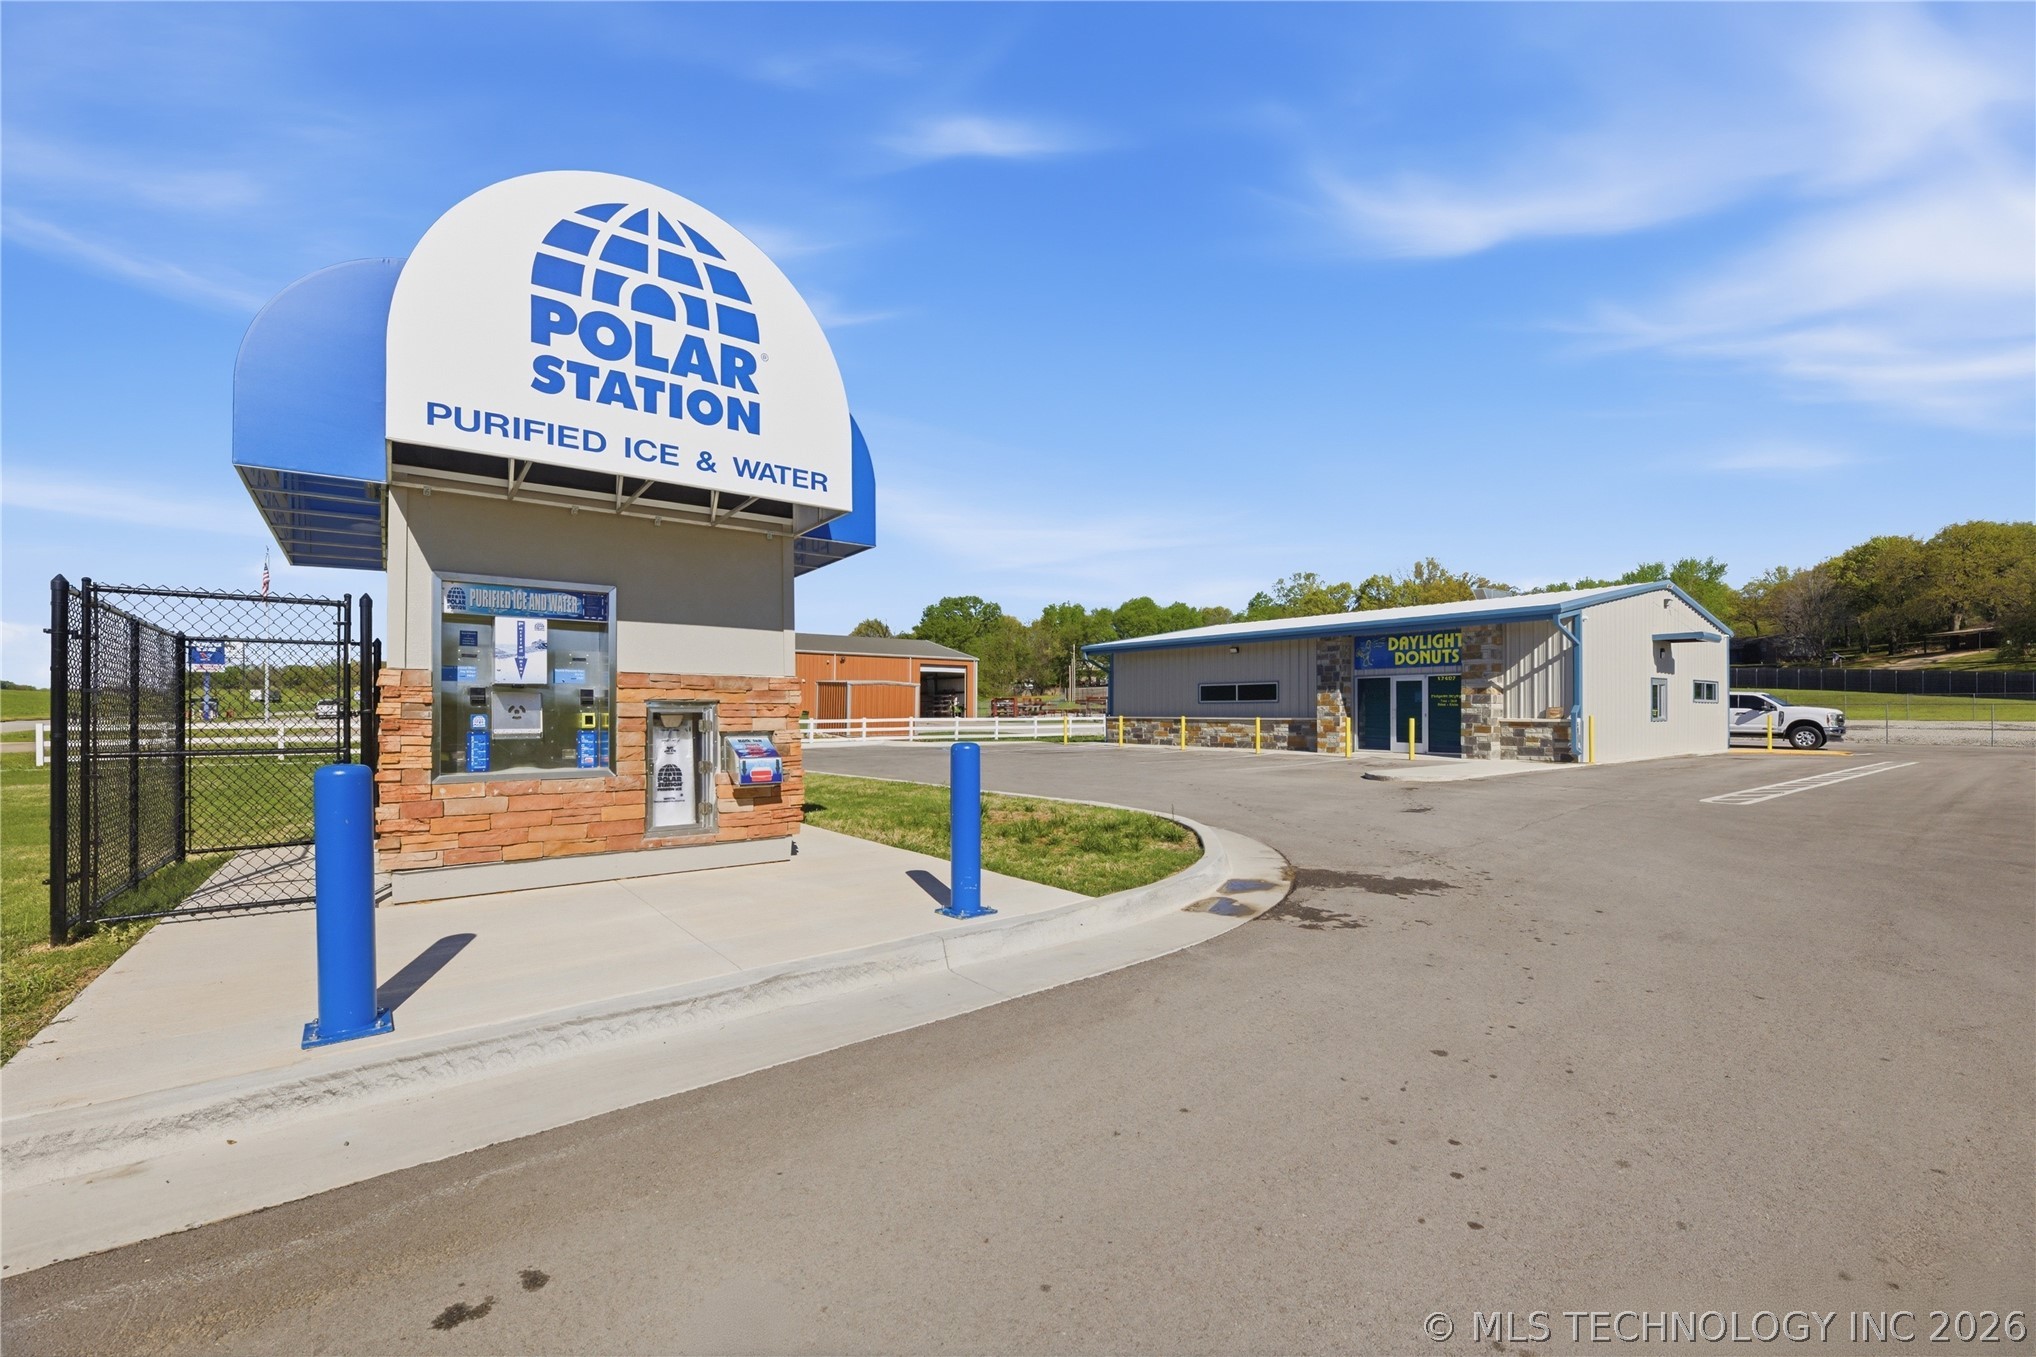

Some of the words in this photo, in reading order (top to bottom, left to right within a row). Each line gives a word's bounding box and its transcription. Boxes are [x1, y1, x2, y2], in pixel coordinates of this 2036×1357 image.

[531, 294, 760, 394] POLAR
[530, 354, 761, 435] STATION
[426, 402, 607, 453] PURIFIED
[625, 437, 680, 467] ICE
[696, 451, 718, 473] &
[733, 457, 829, 492] WATER
[469, 588, 511, 609] PURIFIED
[513, 590, 528, 610] ICE
[529, 592, 547, 611] AND
[548, 594, 579, 613] WATER
[1388, 633, 1462, 651] DAYLIGHT
[1395, 650, 1460, 665] DONUTS
